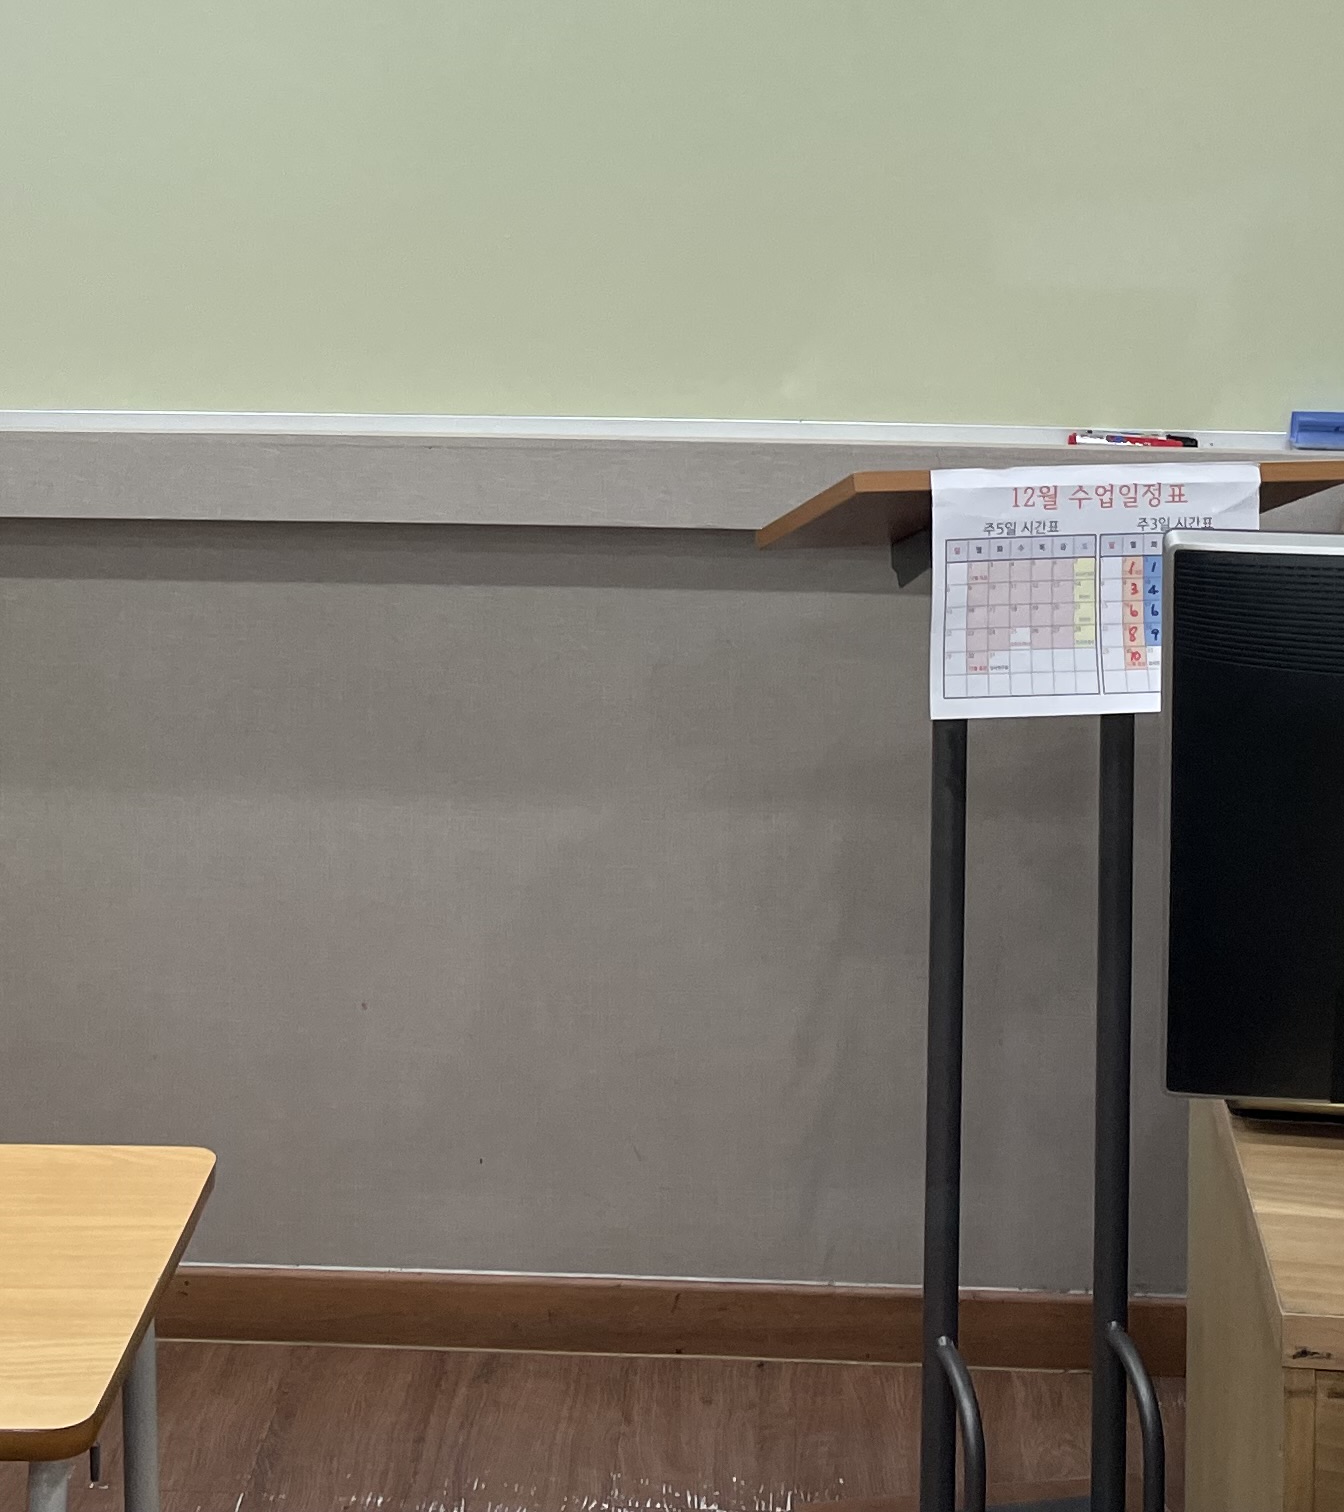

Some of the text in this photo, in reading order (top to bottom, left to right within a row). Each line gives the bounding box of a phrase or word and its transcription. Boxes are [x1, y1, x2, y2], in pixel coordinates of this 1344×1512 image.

[1012, 482, 1189, 511] 12월 수업일정표
[983, 520, 1060, 536] 주5일 시간표
